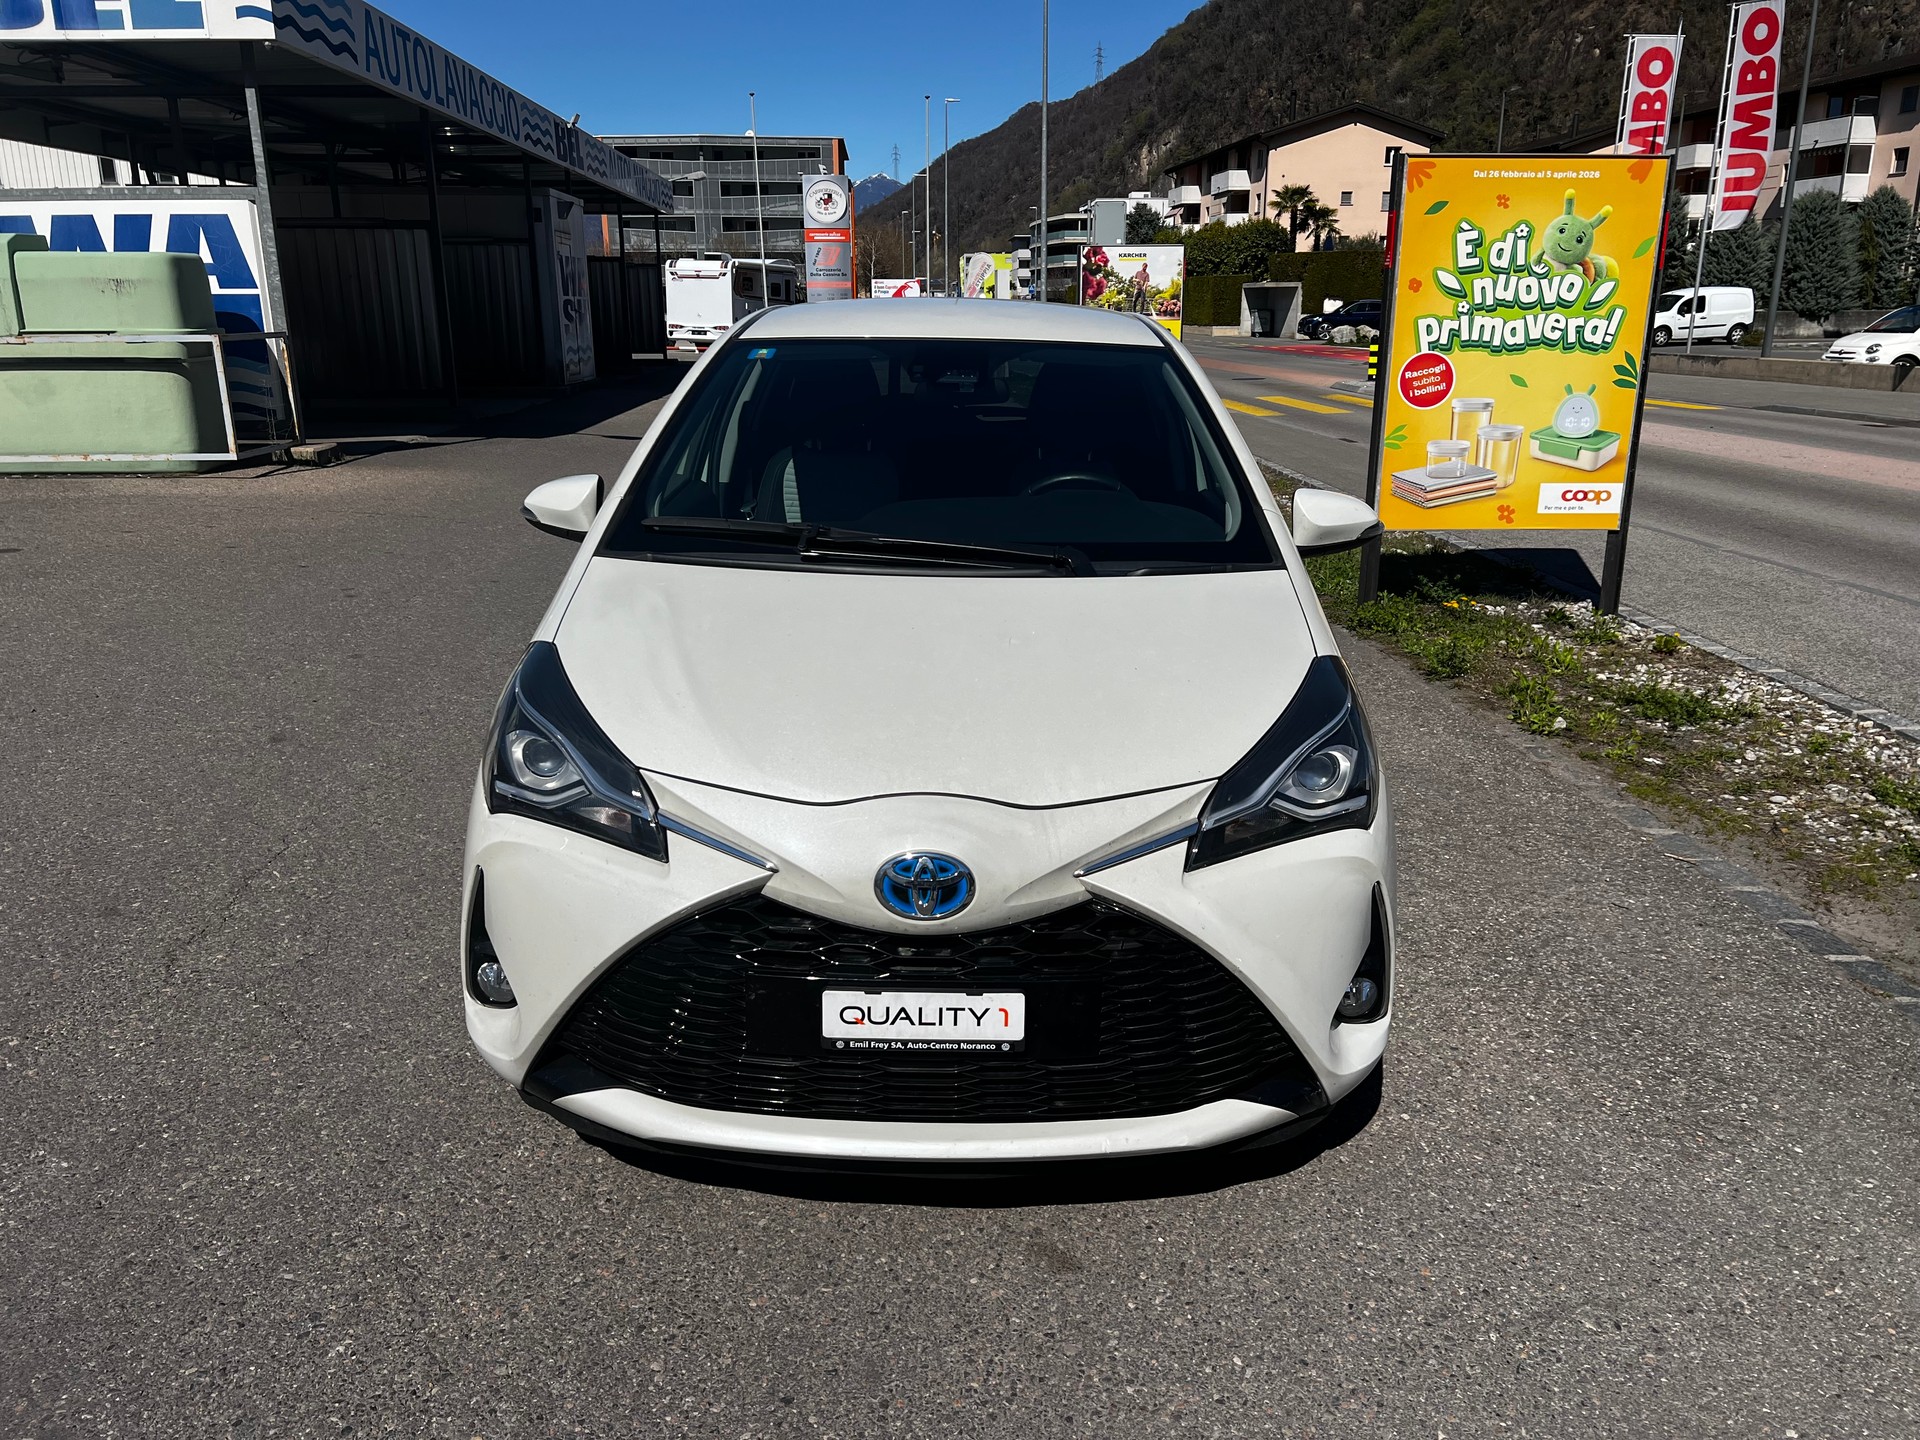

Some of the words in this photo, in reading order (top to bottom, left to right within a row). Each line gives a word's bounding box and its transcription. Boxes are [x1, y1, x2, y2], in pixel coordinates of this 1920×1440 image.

[1473, 170, 1487, 178] Dal
[1488, 170, 1500, 178] 26
[1500, 170, 1536, 178] febbraio
[1536, 170, 1545, 178] al
[1553, 170, 1578, 179] aprile
[1578, 170, 1600, 179] 2026
[1455, 221, 1481, 269] È
[1489, 223, 1531, 269] di
[975, 264, 992, 287] STUPPIA
[1472, 273, 1584, 306] nuovo
[1417, 303, 1625, 352] primavera!
[1405, 363, 1446, 379] Raccogli
[1412, 375, 1441, 387] subito
[1414, 382, 1447, 396] bollini!
[1561, 489, 1612, 505] coop
[839, 1005, 991, 1027] QUALITY
[998, 1007, 1009, 1027] 1
[850, 1040, 869, 1049] Emil
[870, 1041, 890, 1050] Frey
[890, 1041, 905, 1050] SA,
[906, 1042, 958, 1050] Auto-Centro
[960, 1042, 996, 1050] Noranco
